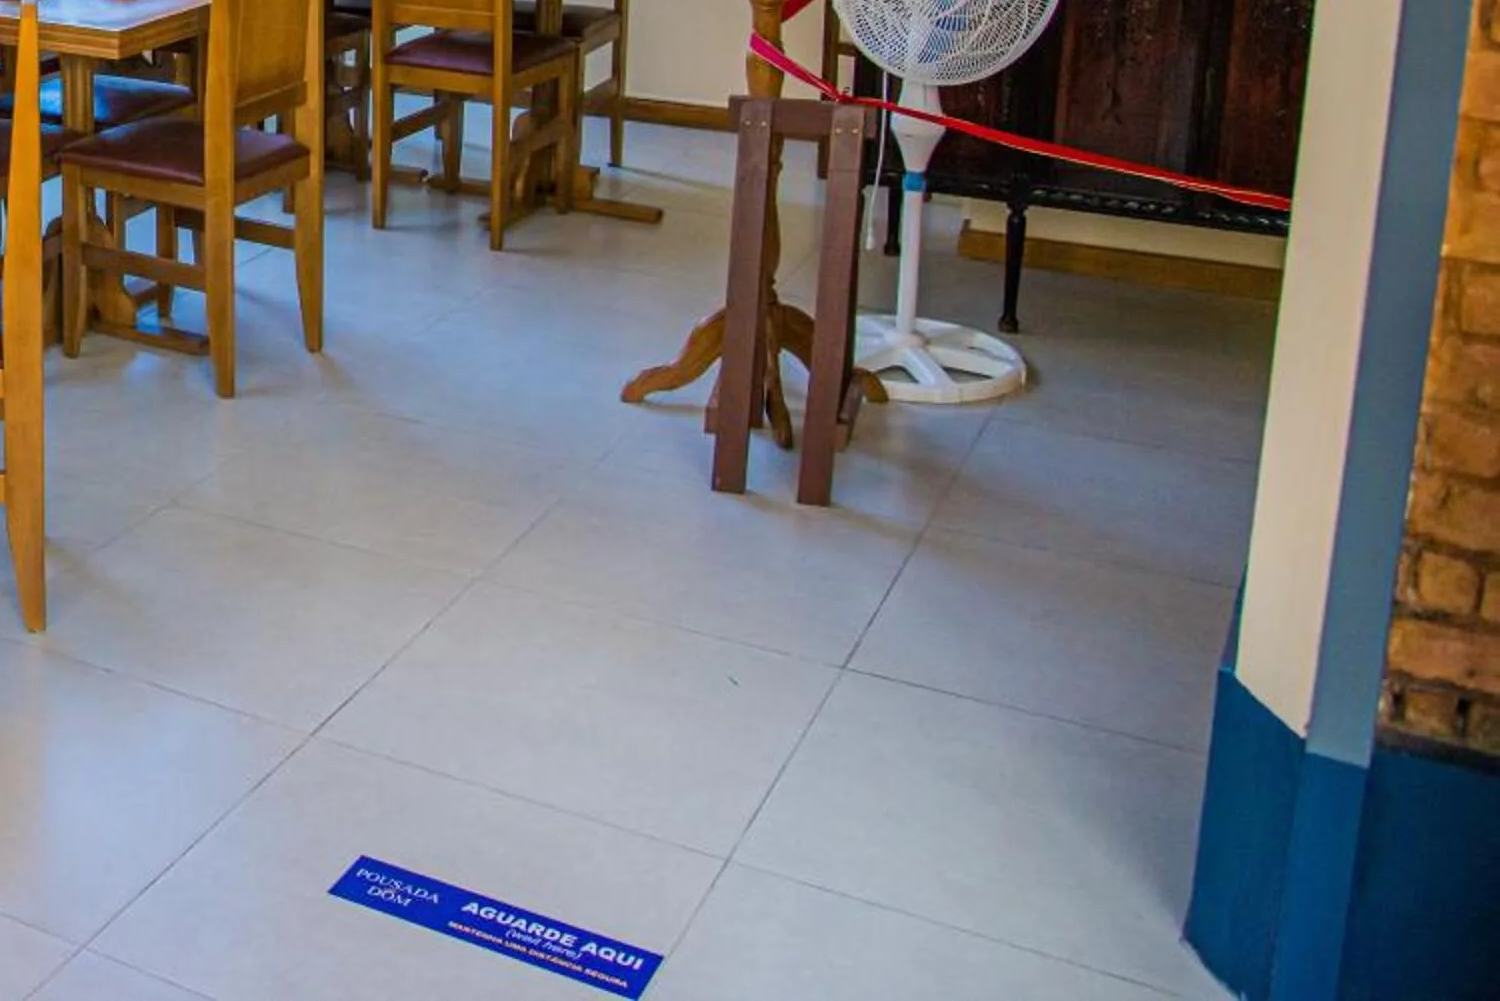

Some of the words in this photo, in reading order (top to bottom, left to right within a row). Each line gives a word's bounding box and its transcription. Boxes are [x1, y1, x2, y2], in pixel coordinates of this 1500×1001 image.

[356, 868, 440, 903] POUSADA
[367, 886, 412, 906] DOM
[461, 902, 578, 946] AGUARDE
[580, 942, 644, 970] AQUI
